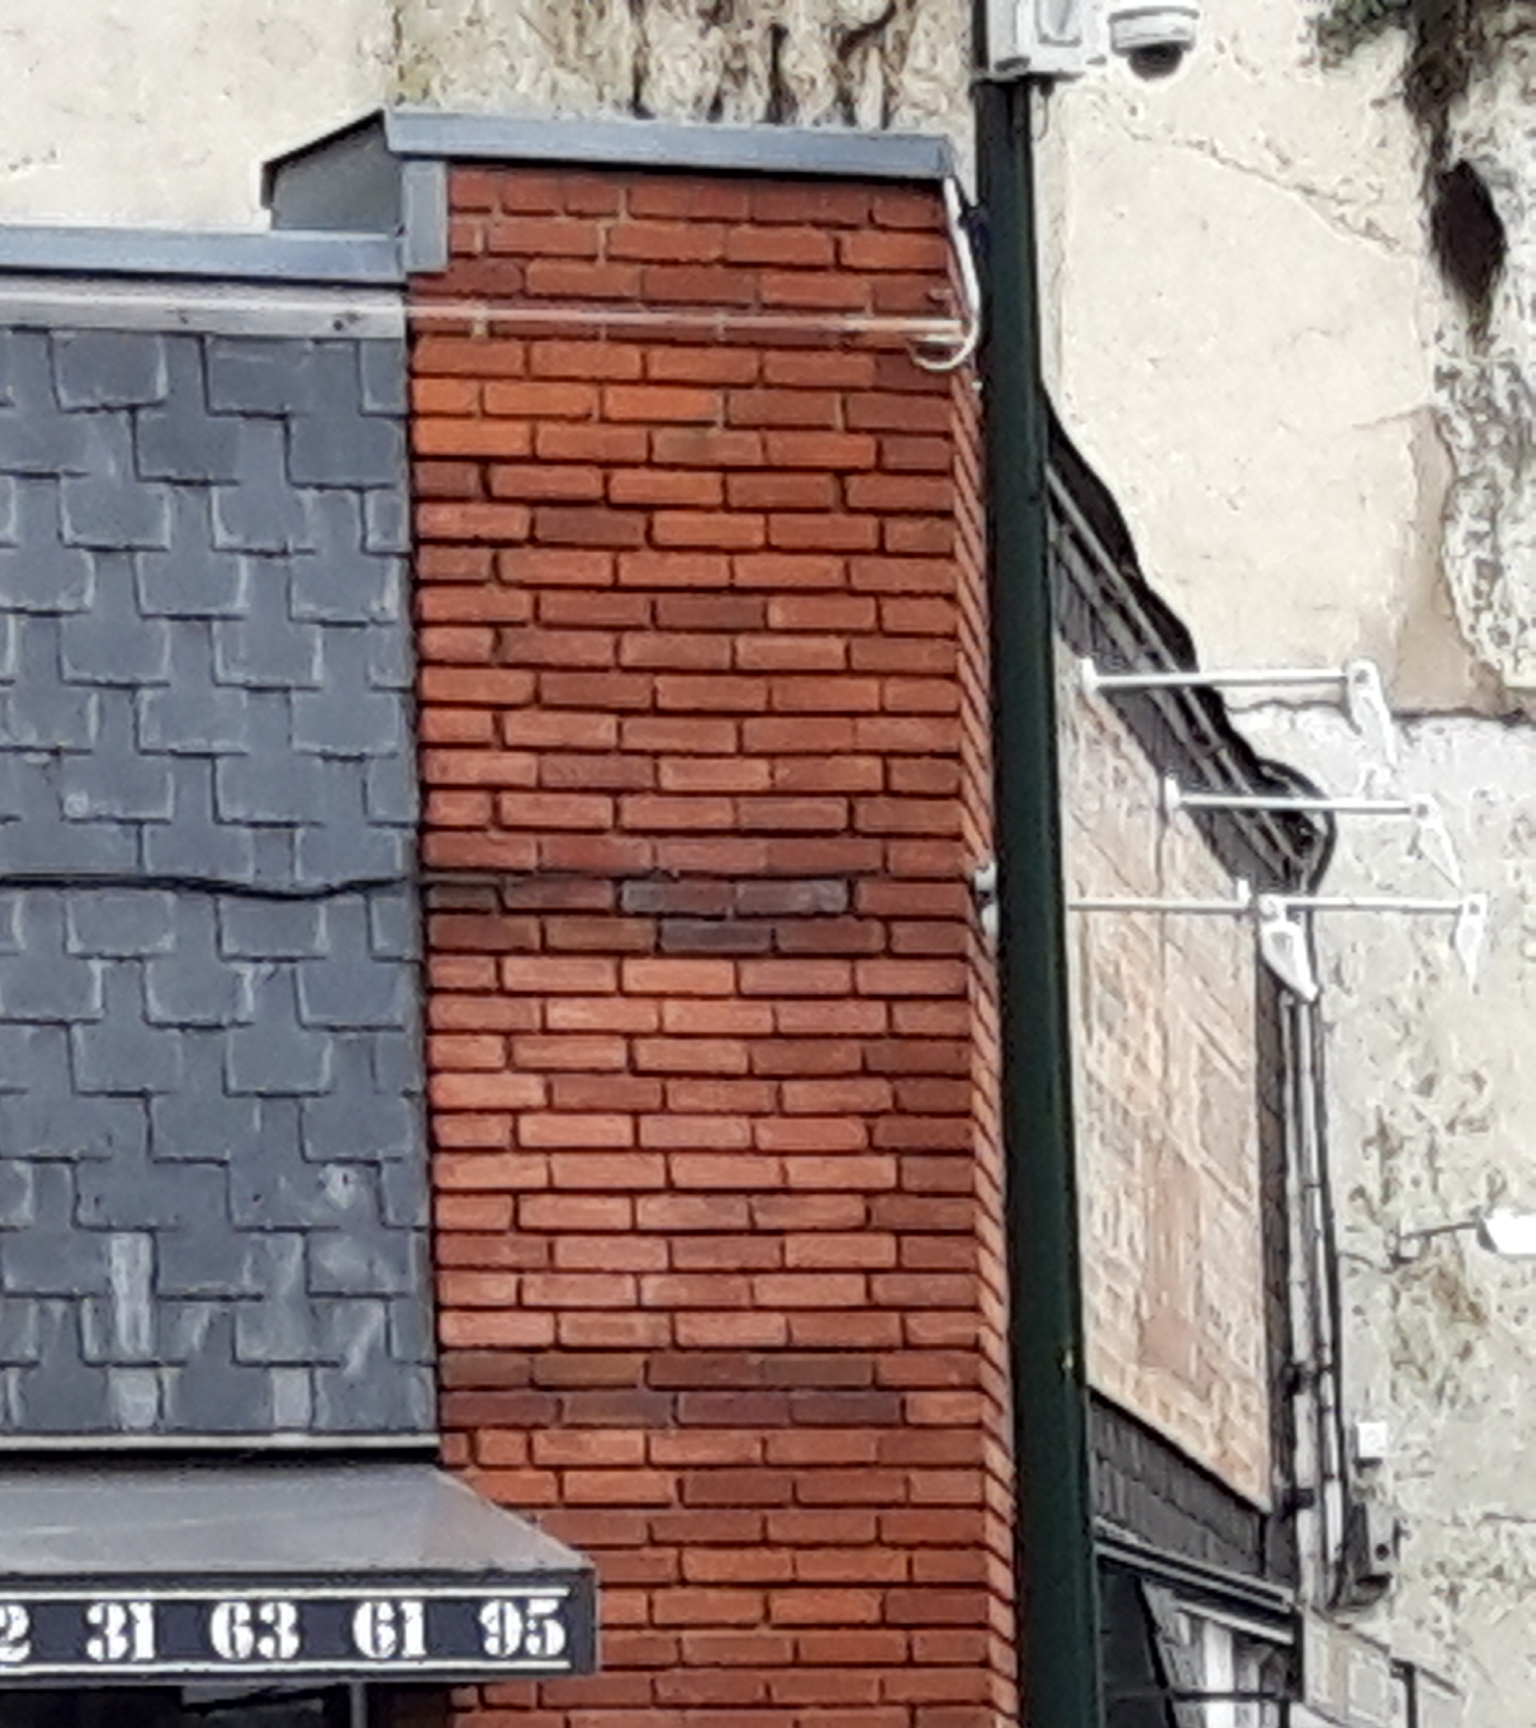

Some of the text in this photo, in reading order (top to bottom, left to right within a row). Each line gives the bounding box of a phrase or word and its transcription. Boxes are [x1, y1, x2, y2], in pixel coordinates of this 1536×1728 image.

[85, 1602, 157, 1662] 31
[208, 1601, 301, 1661] 63
[351, 1599, 428, 1660] 61
[477, 1597, 568, 1659] 95
